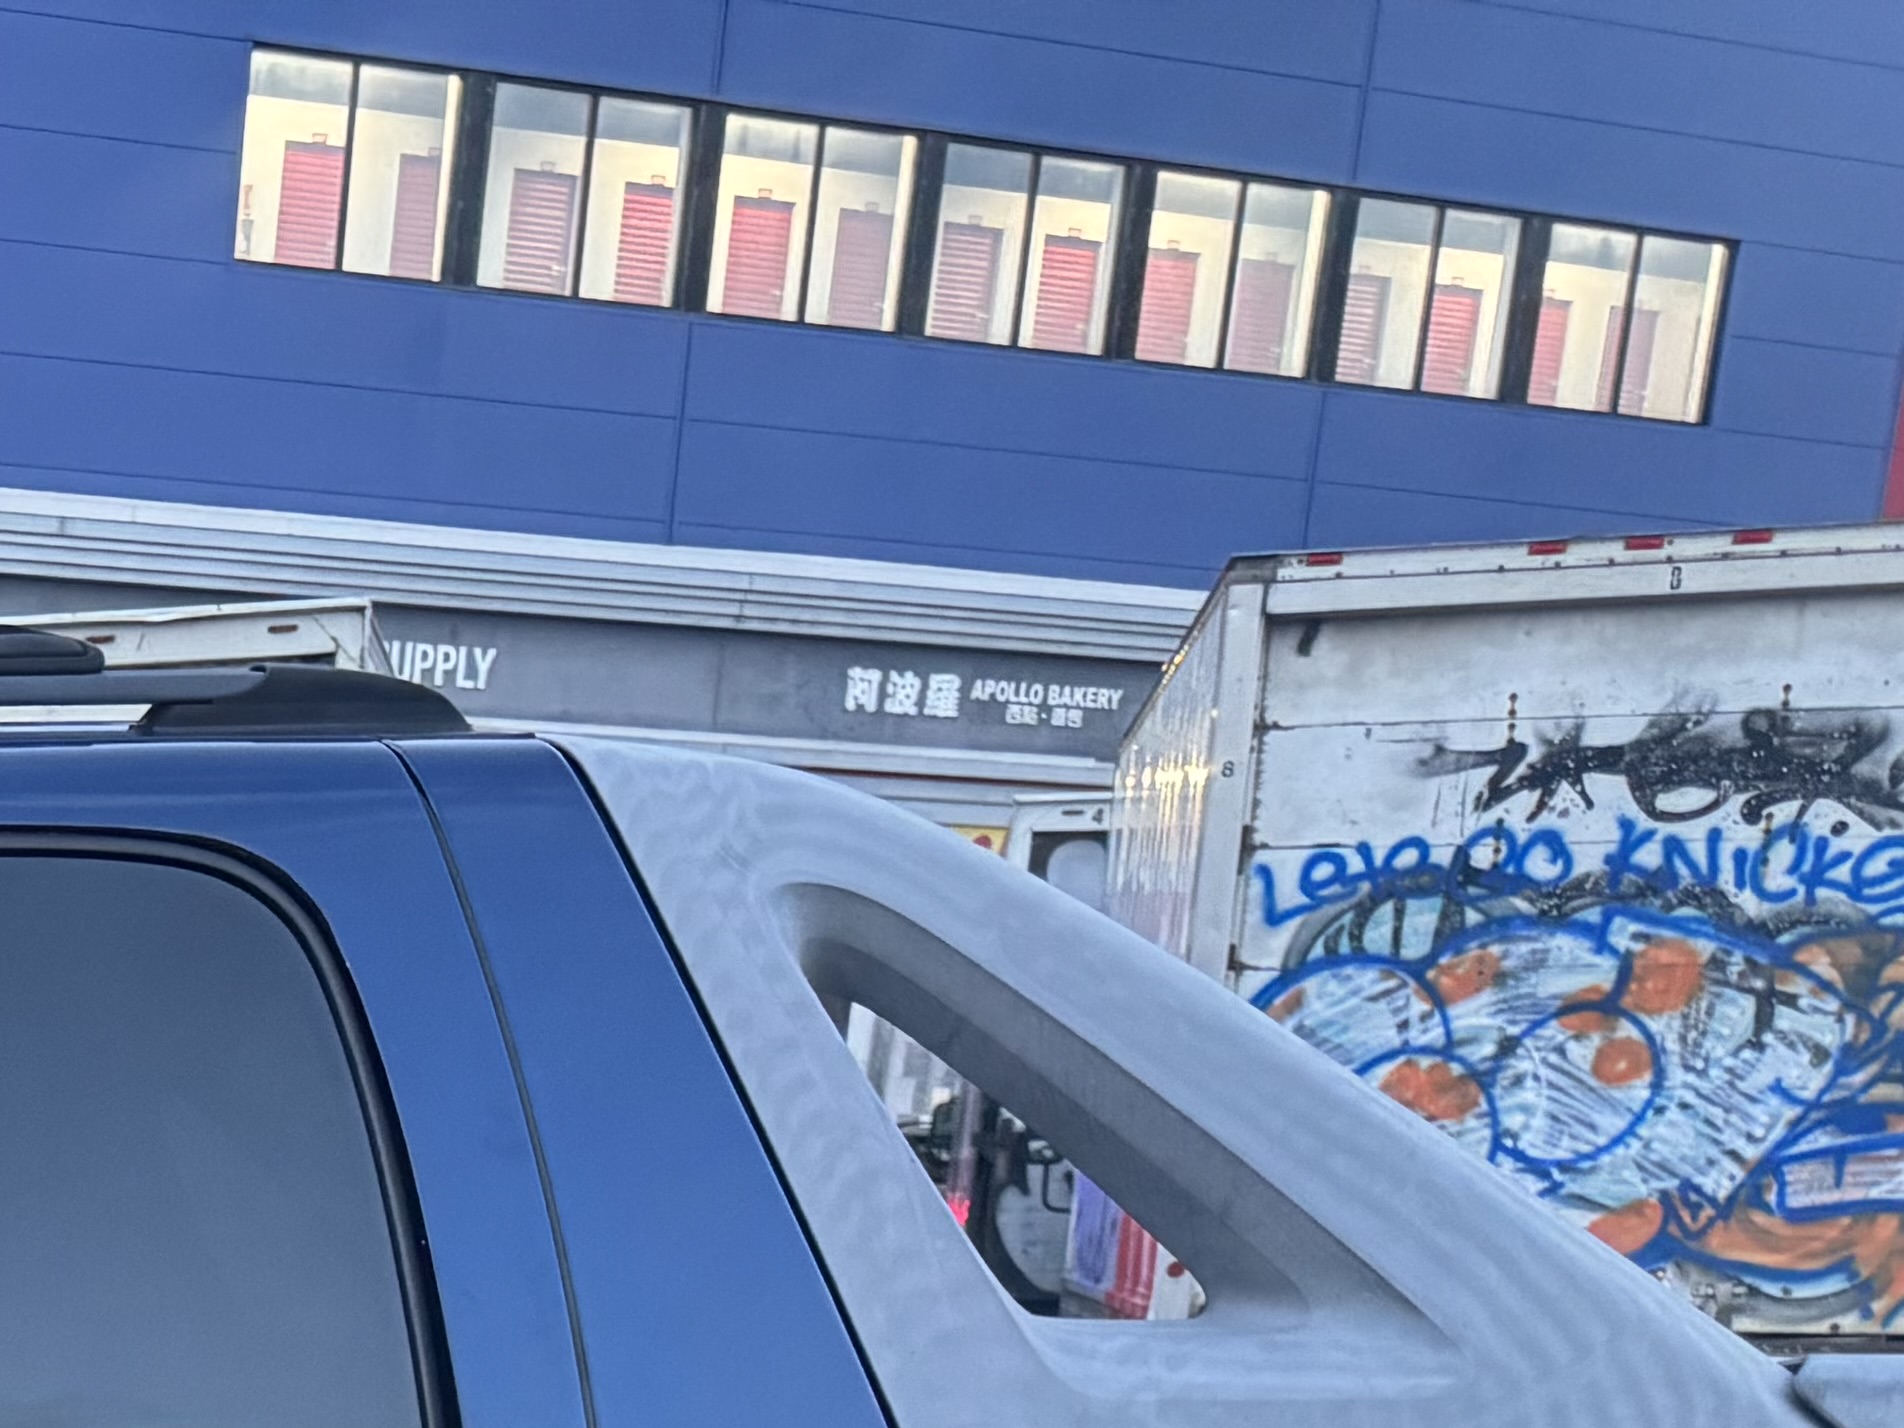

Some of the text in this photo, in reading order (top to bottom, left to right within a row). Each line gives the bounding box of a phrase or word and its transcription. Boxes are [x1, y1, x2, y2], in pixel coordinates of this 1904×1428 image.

[844, 666, 962, 719] 阿波羅
[970, 678, 1124, 710] APOLLO BAKERY
